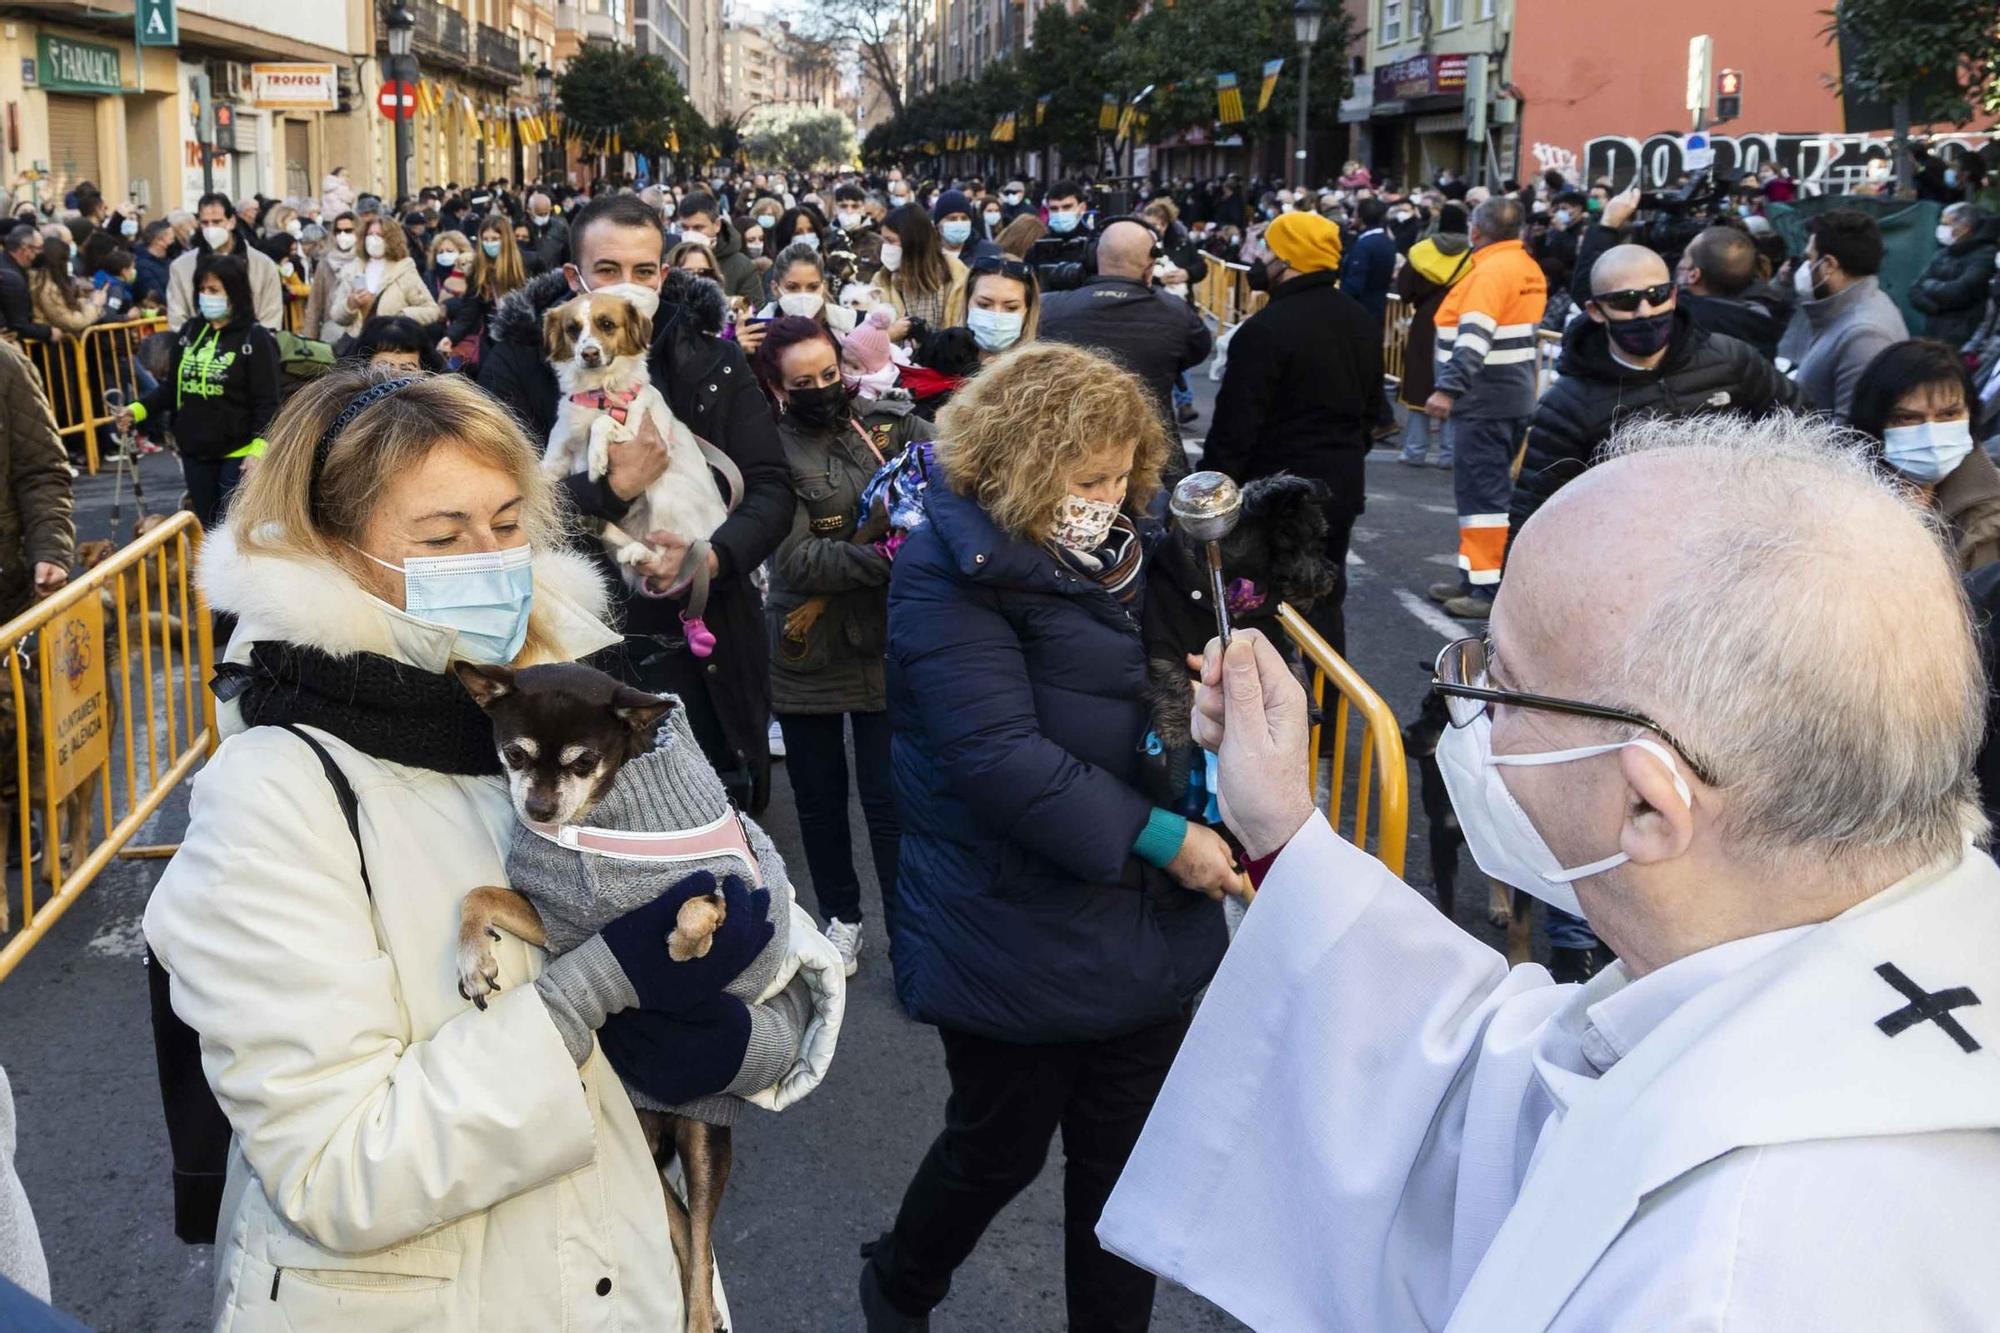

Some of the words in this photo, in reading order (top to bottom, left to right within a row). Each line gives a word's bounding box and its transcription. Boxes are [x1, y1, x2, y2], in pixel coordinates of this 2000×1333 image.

[61, 44, 120, 87] FARMACIA
[266, 74, 321, 86] TROFEOS
[58, 743, 69, 767] DE
